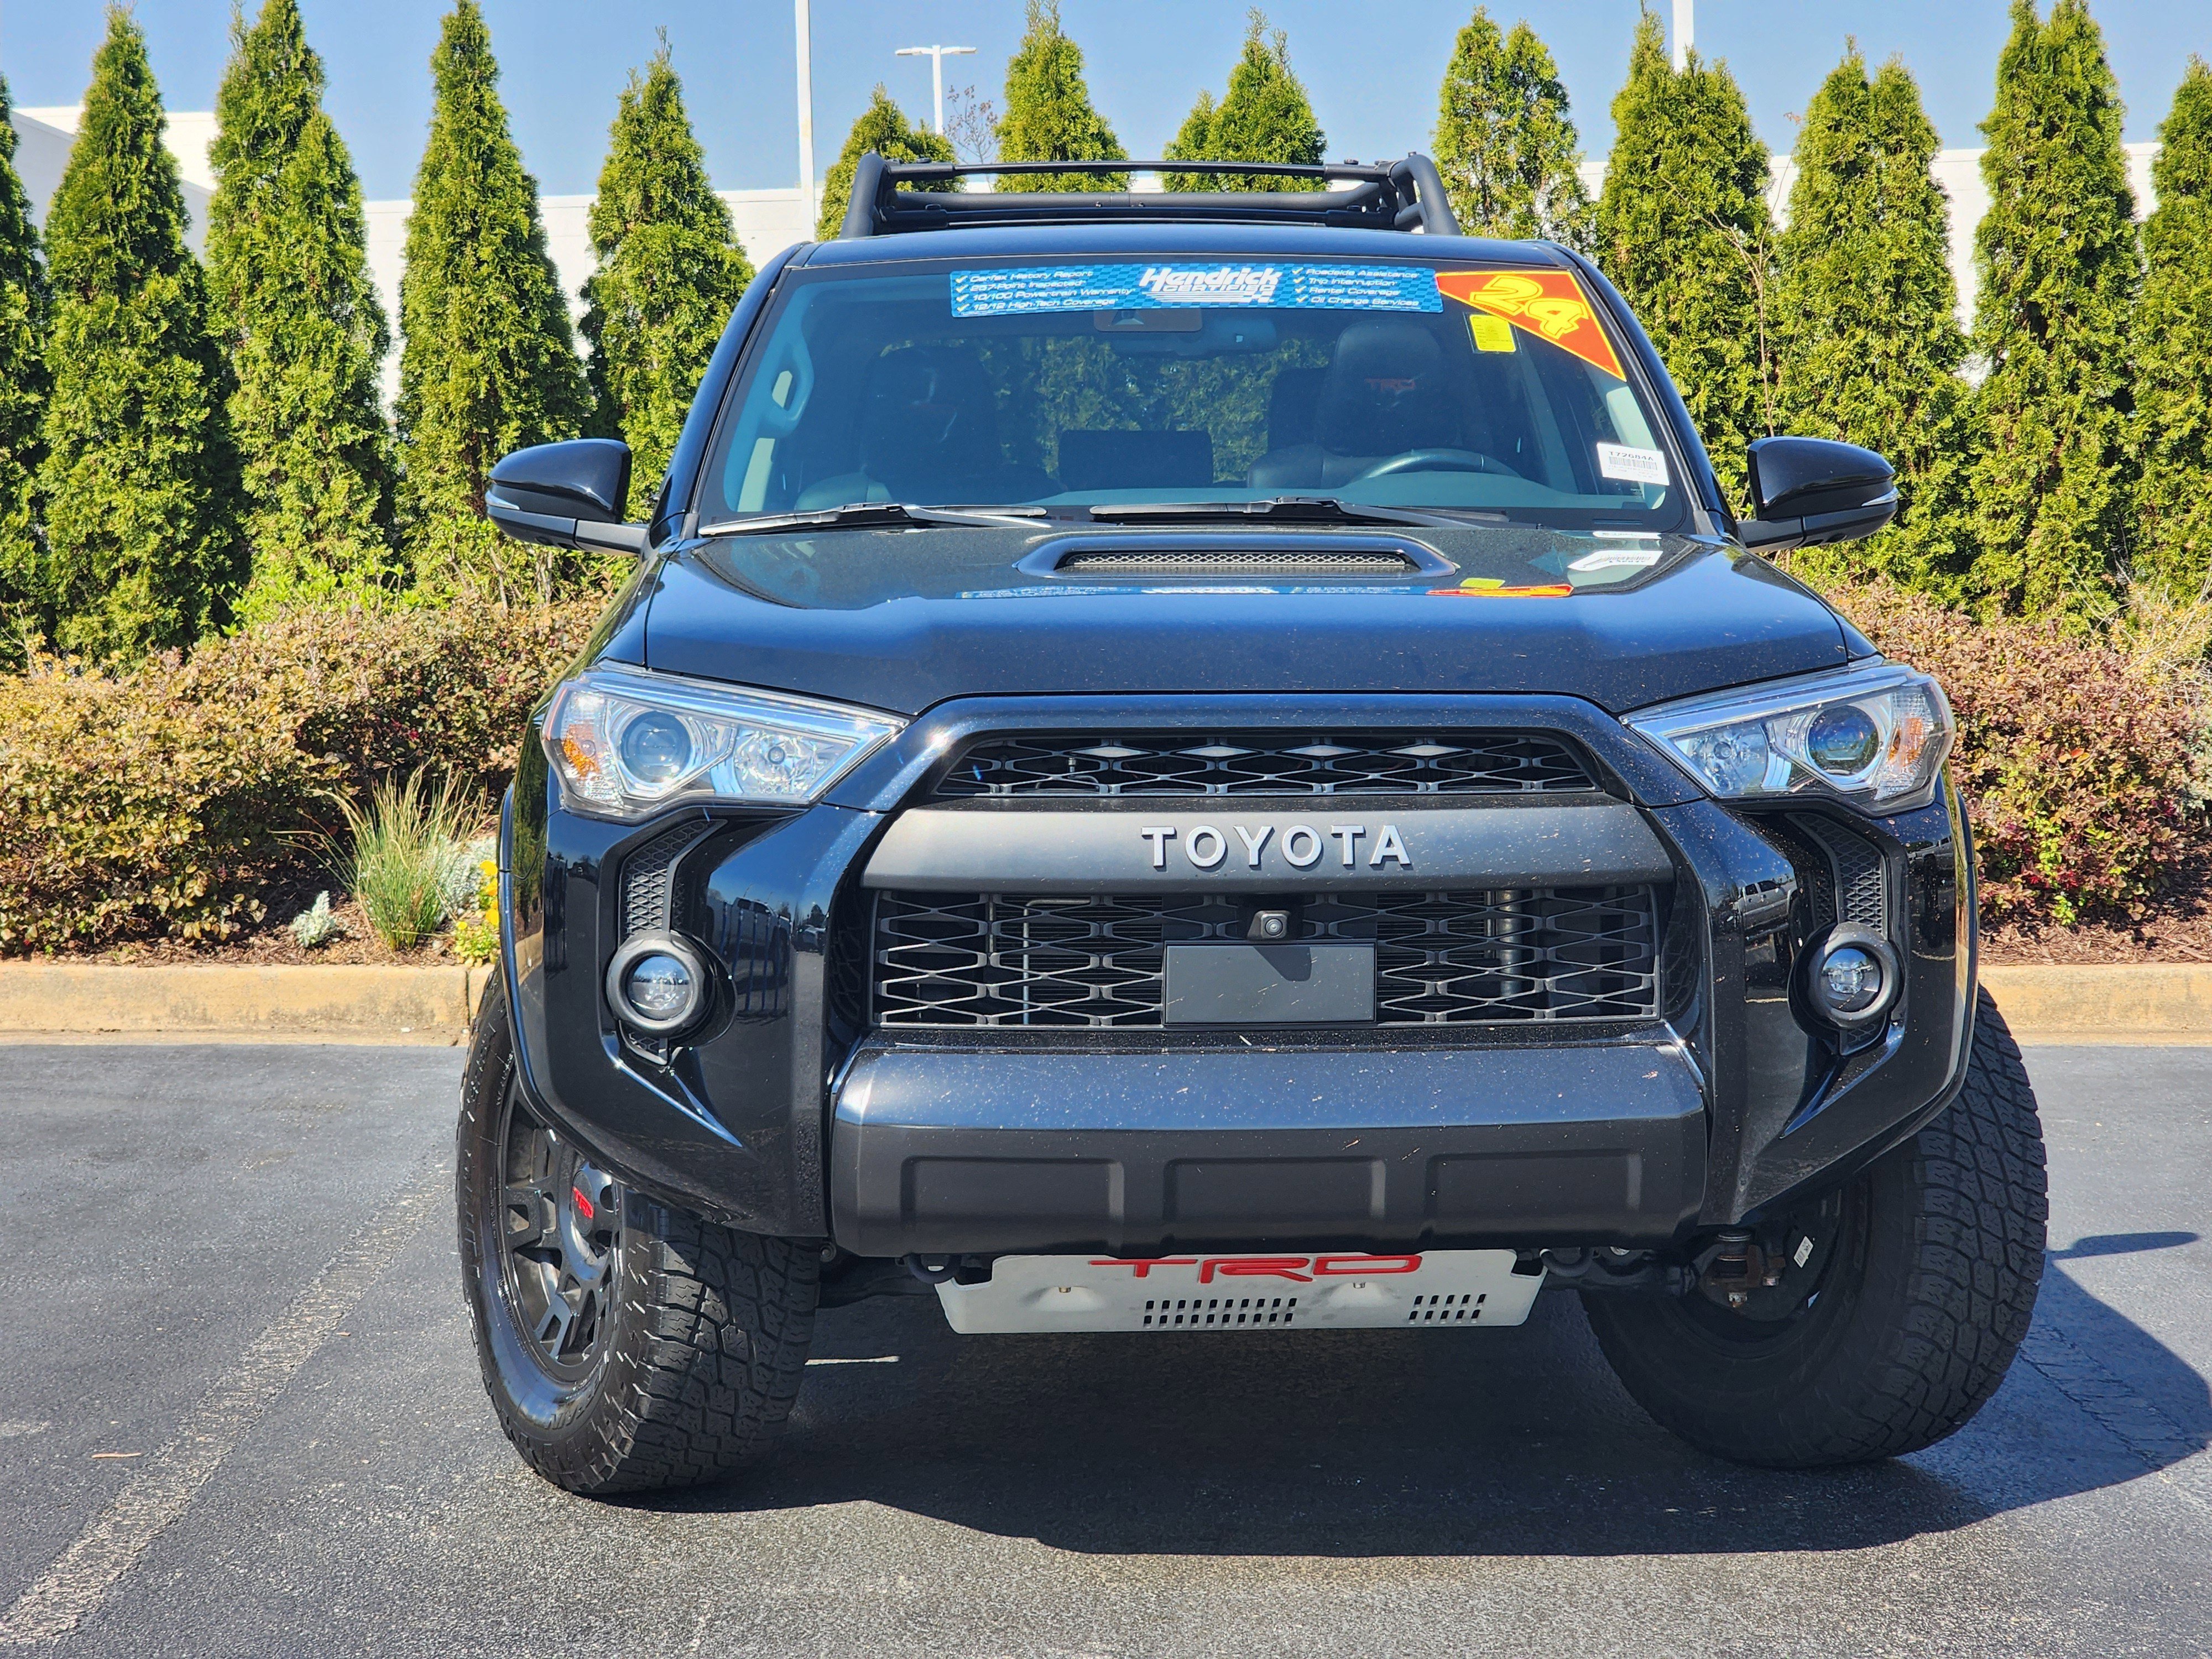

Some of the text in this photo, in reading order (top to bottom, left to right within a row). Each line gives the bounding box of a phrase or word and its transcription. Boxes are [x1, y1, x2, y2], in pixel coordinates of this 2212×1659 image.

[970, 274, 1008, 283] Carfax
[1139, 268, 1283, 291] Hendrick
[973, 292, 1014, 301] 10/100
[1015, 290, 1078, 299] Powertrain
[1328, 297, 1369, 305] Change
[1469, 275, 1589, 340] 24
[1141, 825, 1412, 868] TOYOTA
[573, 1186, 594, 1219] TRD
[1089, 1255, 1423, 1284] TRD
